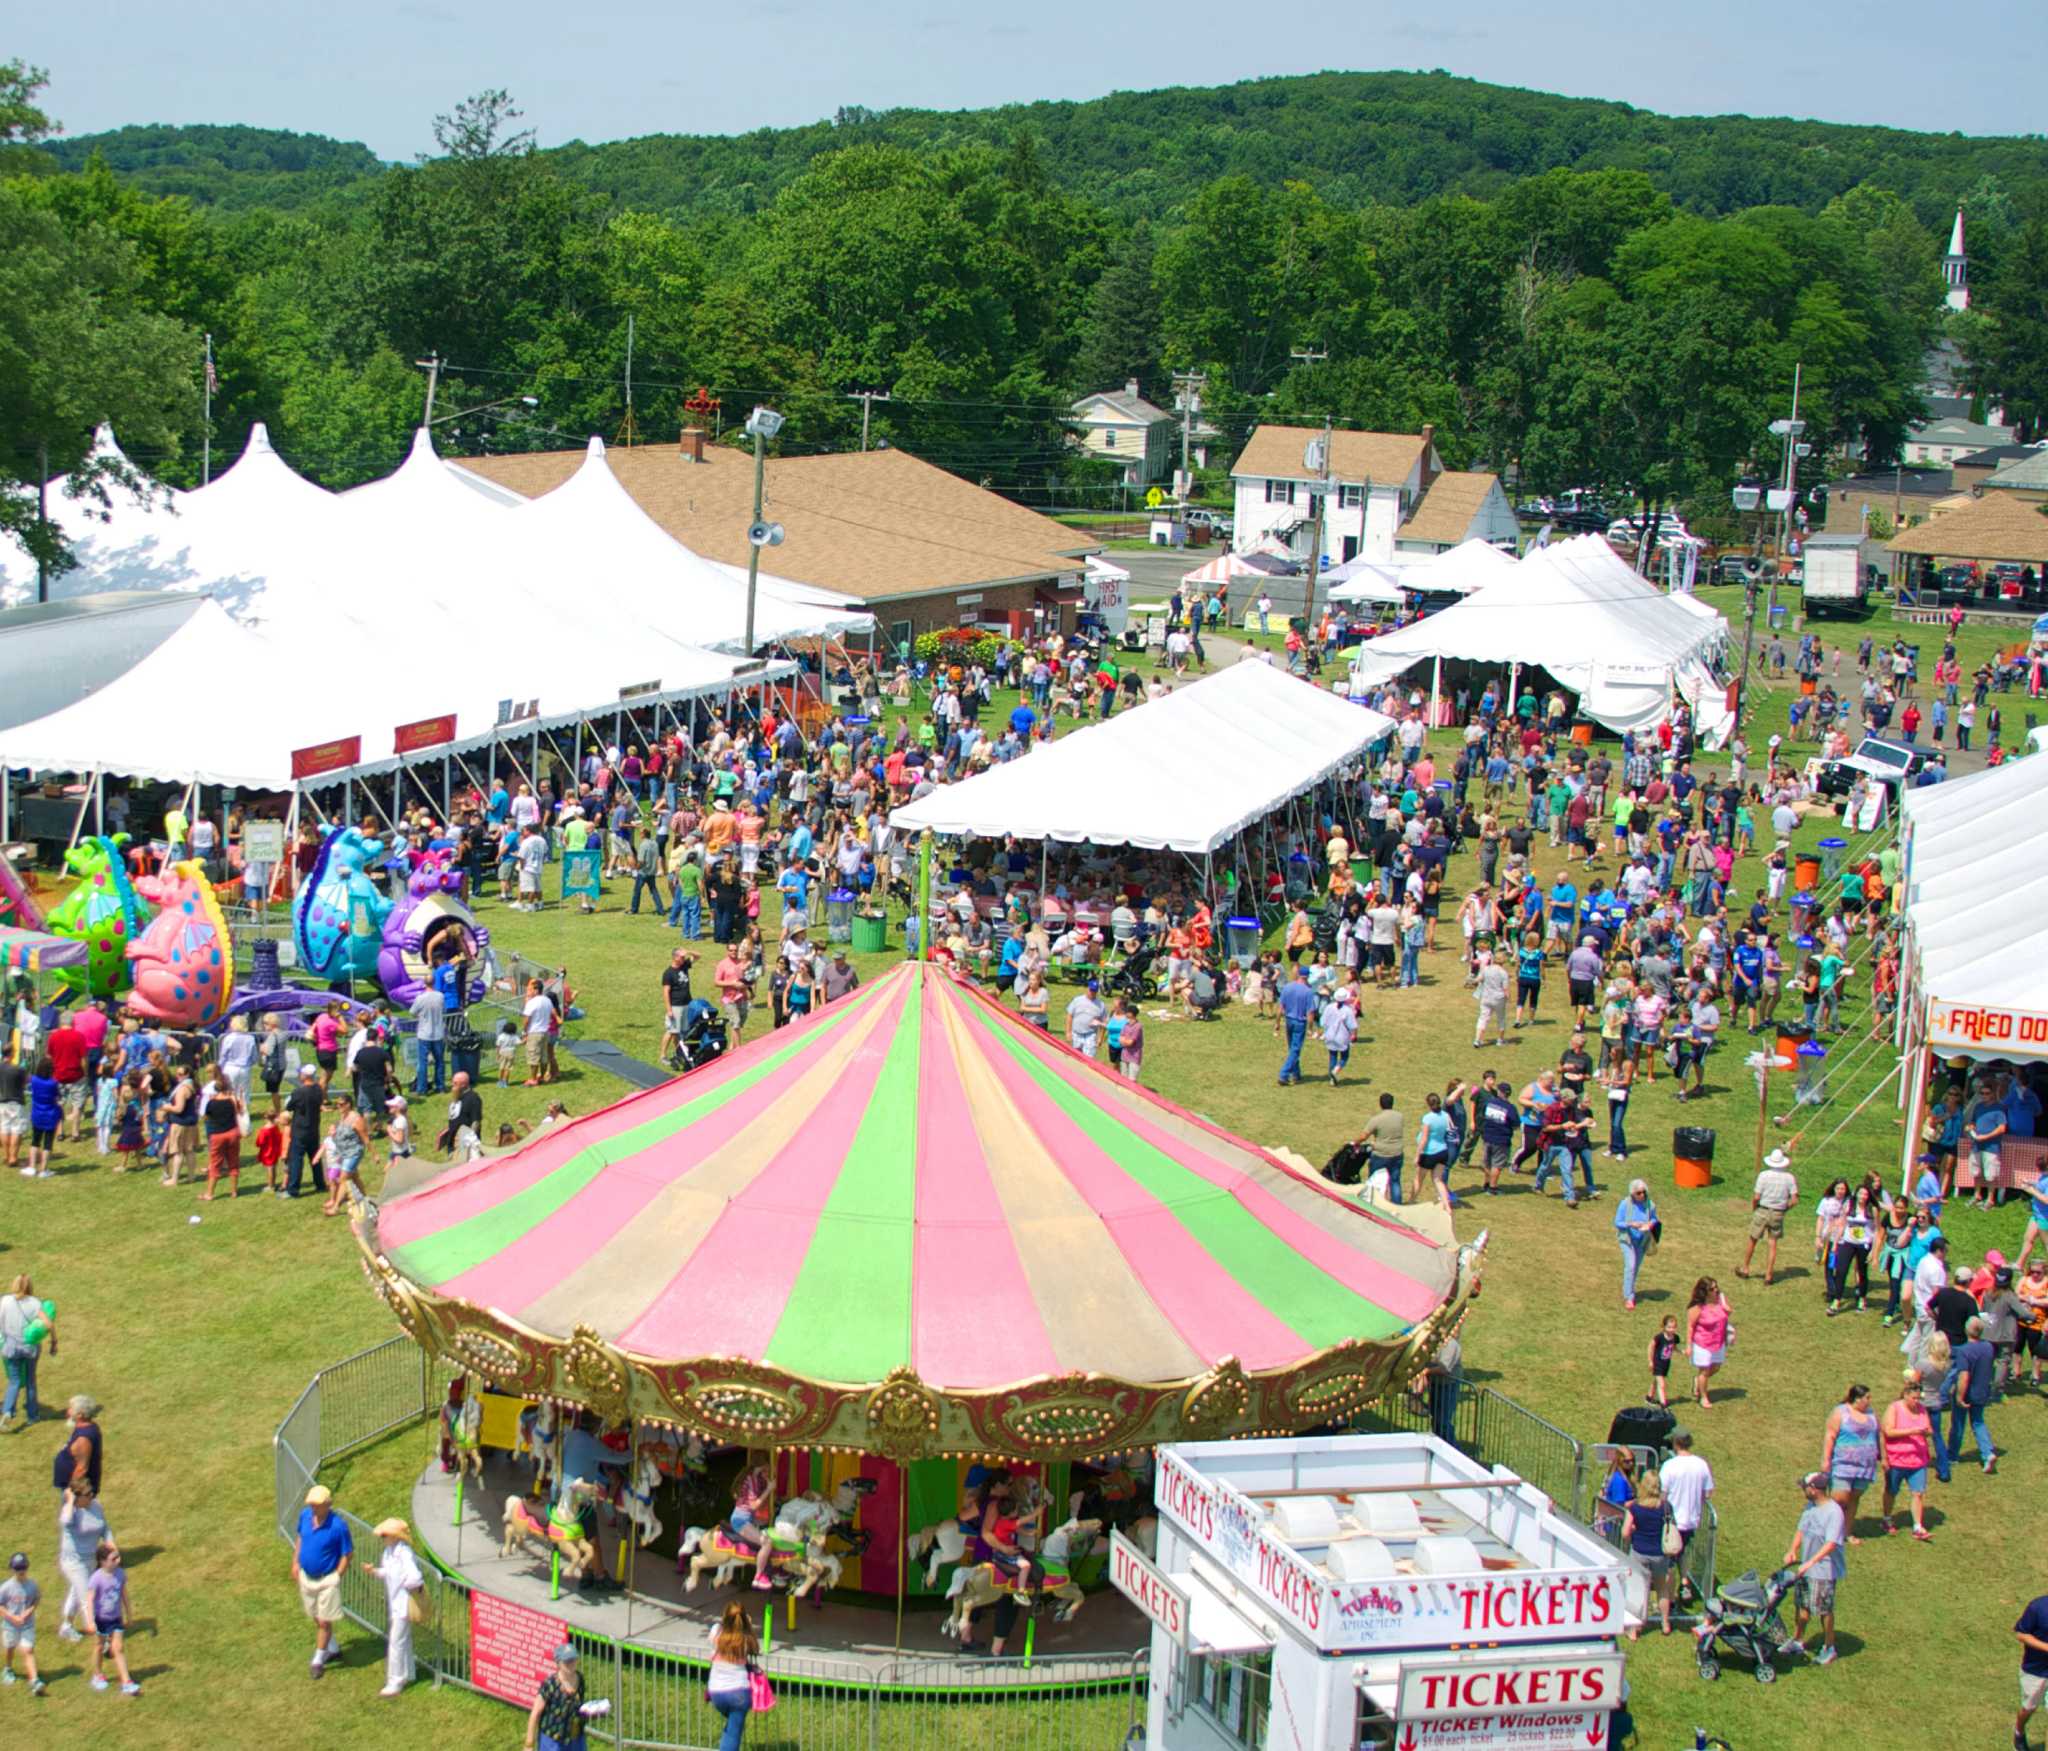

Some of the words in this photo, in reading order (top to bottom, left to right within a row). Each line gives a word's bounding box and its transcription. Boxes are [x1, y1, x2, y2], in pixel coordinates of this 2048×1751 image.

[1102, 595, 1117, 608] AID
[1162, 1460, 1213, 1541] TICKETS
[1116, 1546, 1178, 1632] TICKETS
[1258, 1540, 1320, 1630] TICKETS
[1460, 1580, 1610, 1630] TICKETS
[1421, 1667, 1604, 1709] TICKETS
[1421, 1716, 1495, 1733] TICKET
[1500, 1712, 1584, 1729] Windows
[1446, 1733, 1465, 1745] each
[1471, 1732, 1494, 1744] ticket
